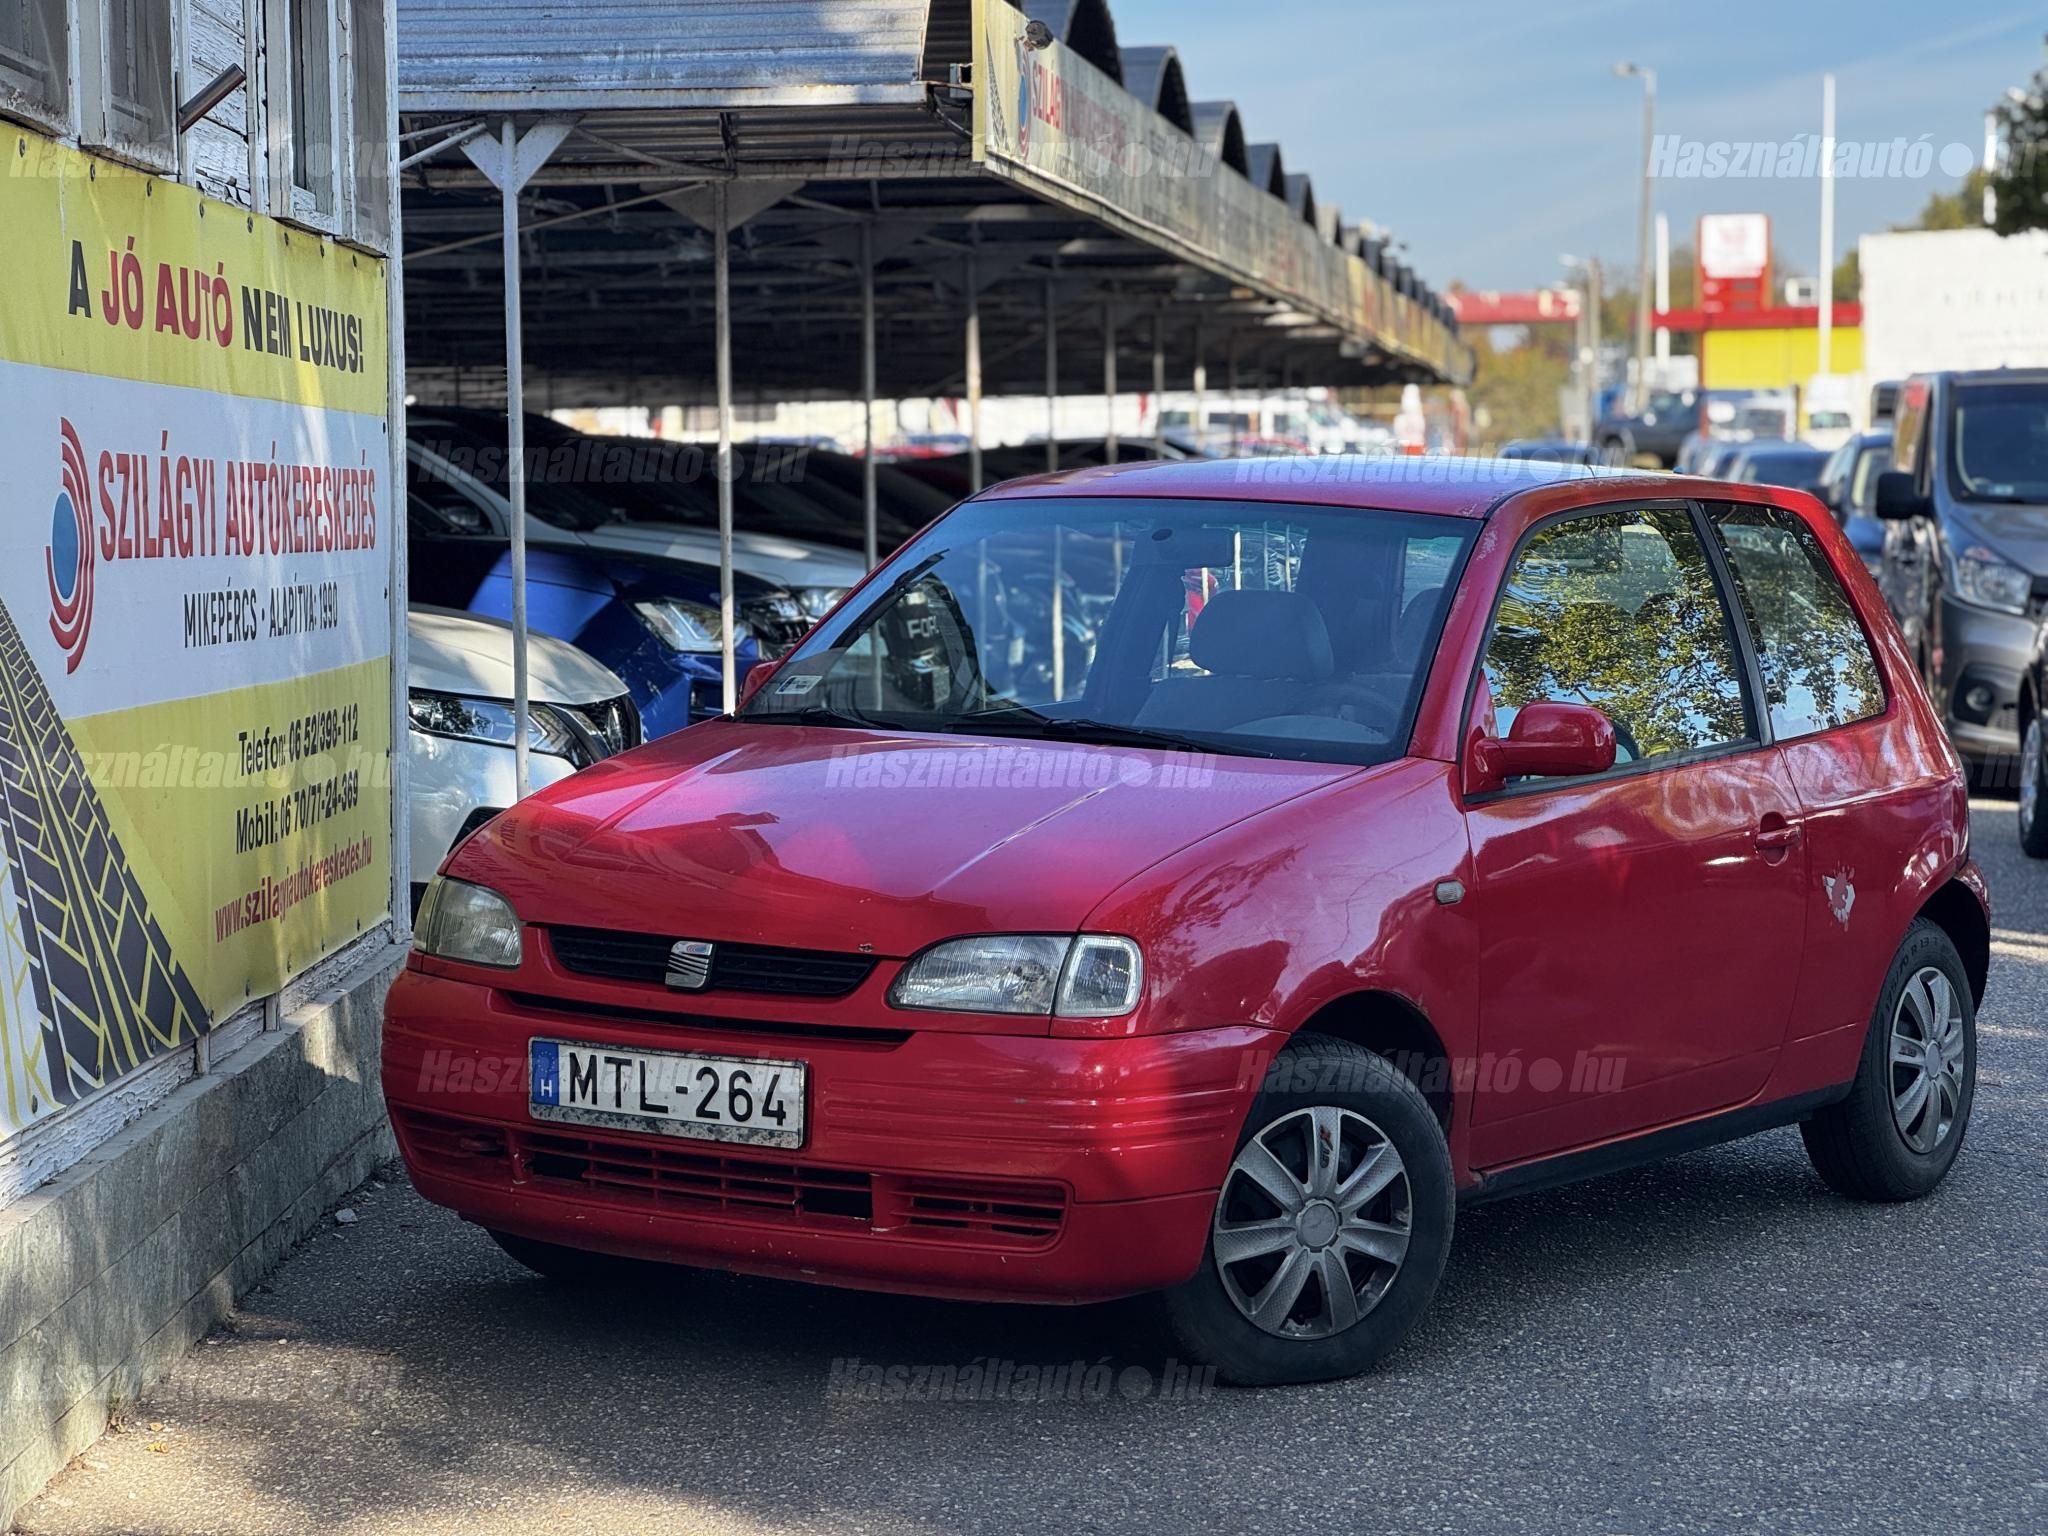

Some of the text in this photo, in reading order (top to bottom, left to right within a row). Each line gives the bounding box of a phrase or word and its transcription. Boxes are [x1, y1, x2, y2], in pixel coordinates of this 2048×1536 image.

[68, 236, 364, 373] A JÓ AUTÓ NEM LUXUS!
[98, 430, 376, 561] SZILÁGYI AUTÓKERESKEDÉS
[183, 573, 338, 649] MIKEPÉRCS ALAPÍTVA: 1990
[238, 703, 359, 777] Telefon: 06 52/398-112
[236, 772, 359, 855] Mobil: 06 70/77-24-369
[215, 830, 373, 944] www.szilagyiautokereskedes.hu
[541, 1079, 552, 1097] H
[568, 1052, 787, 1126] MTL-264
